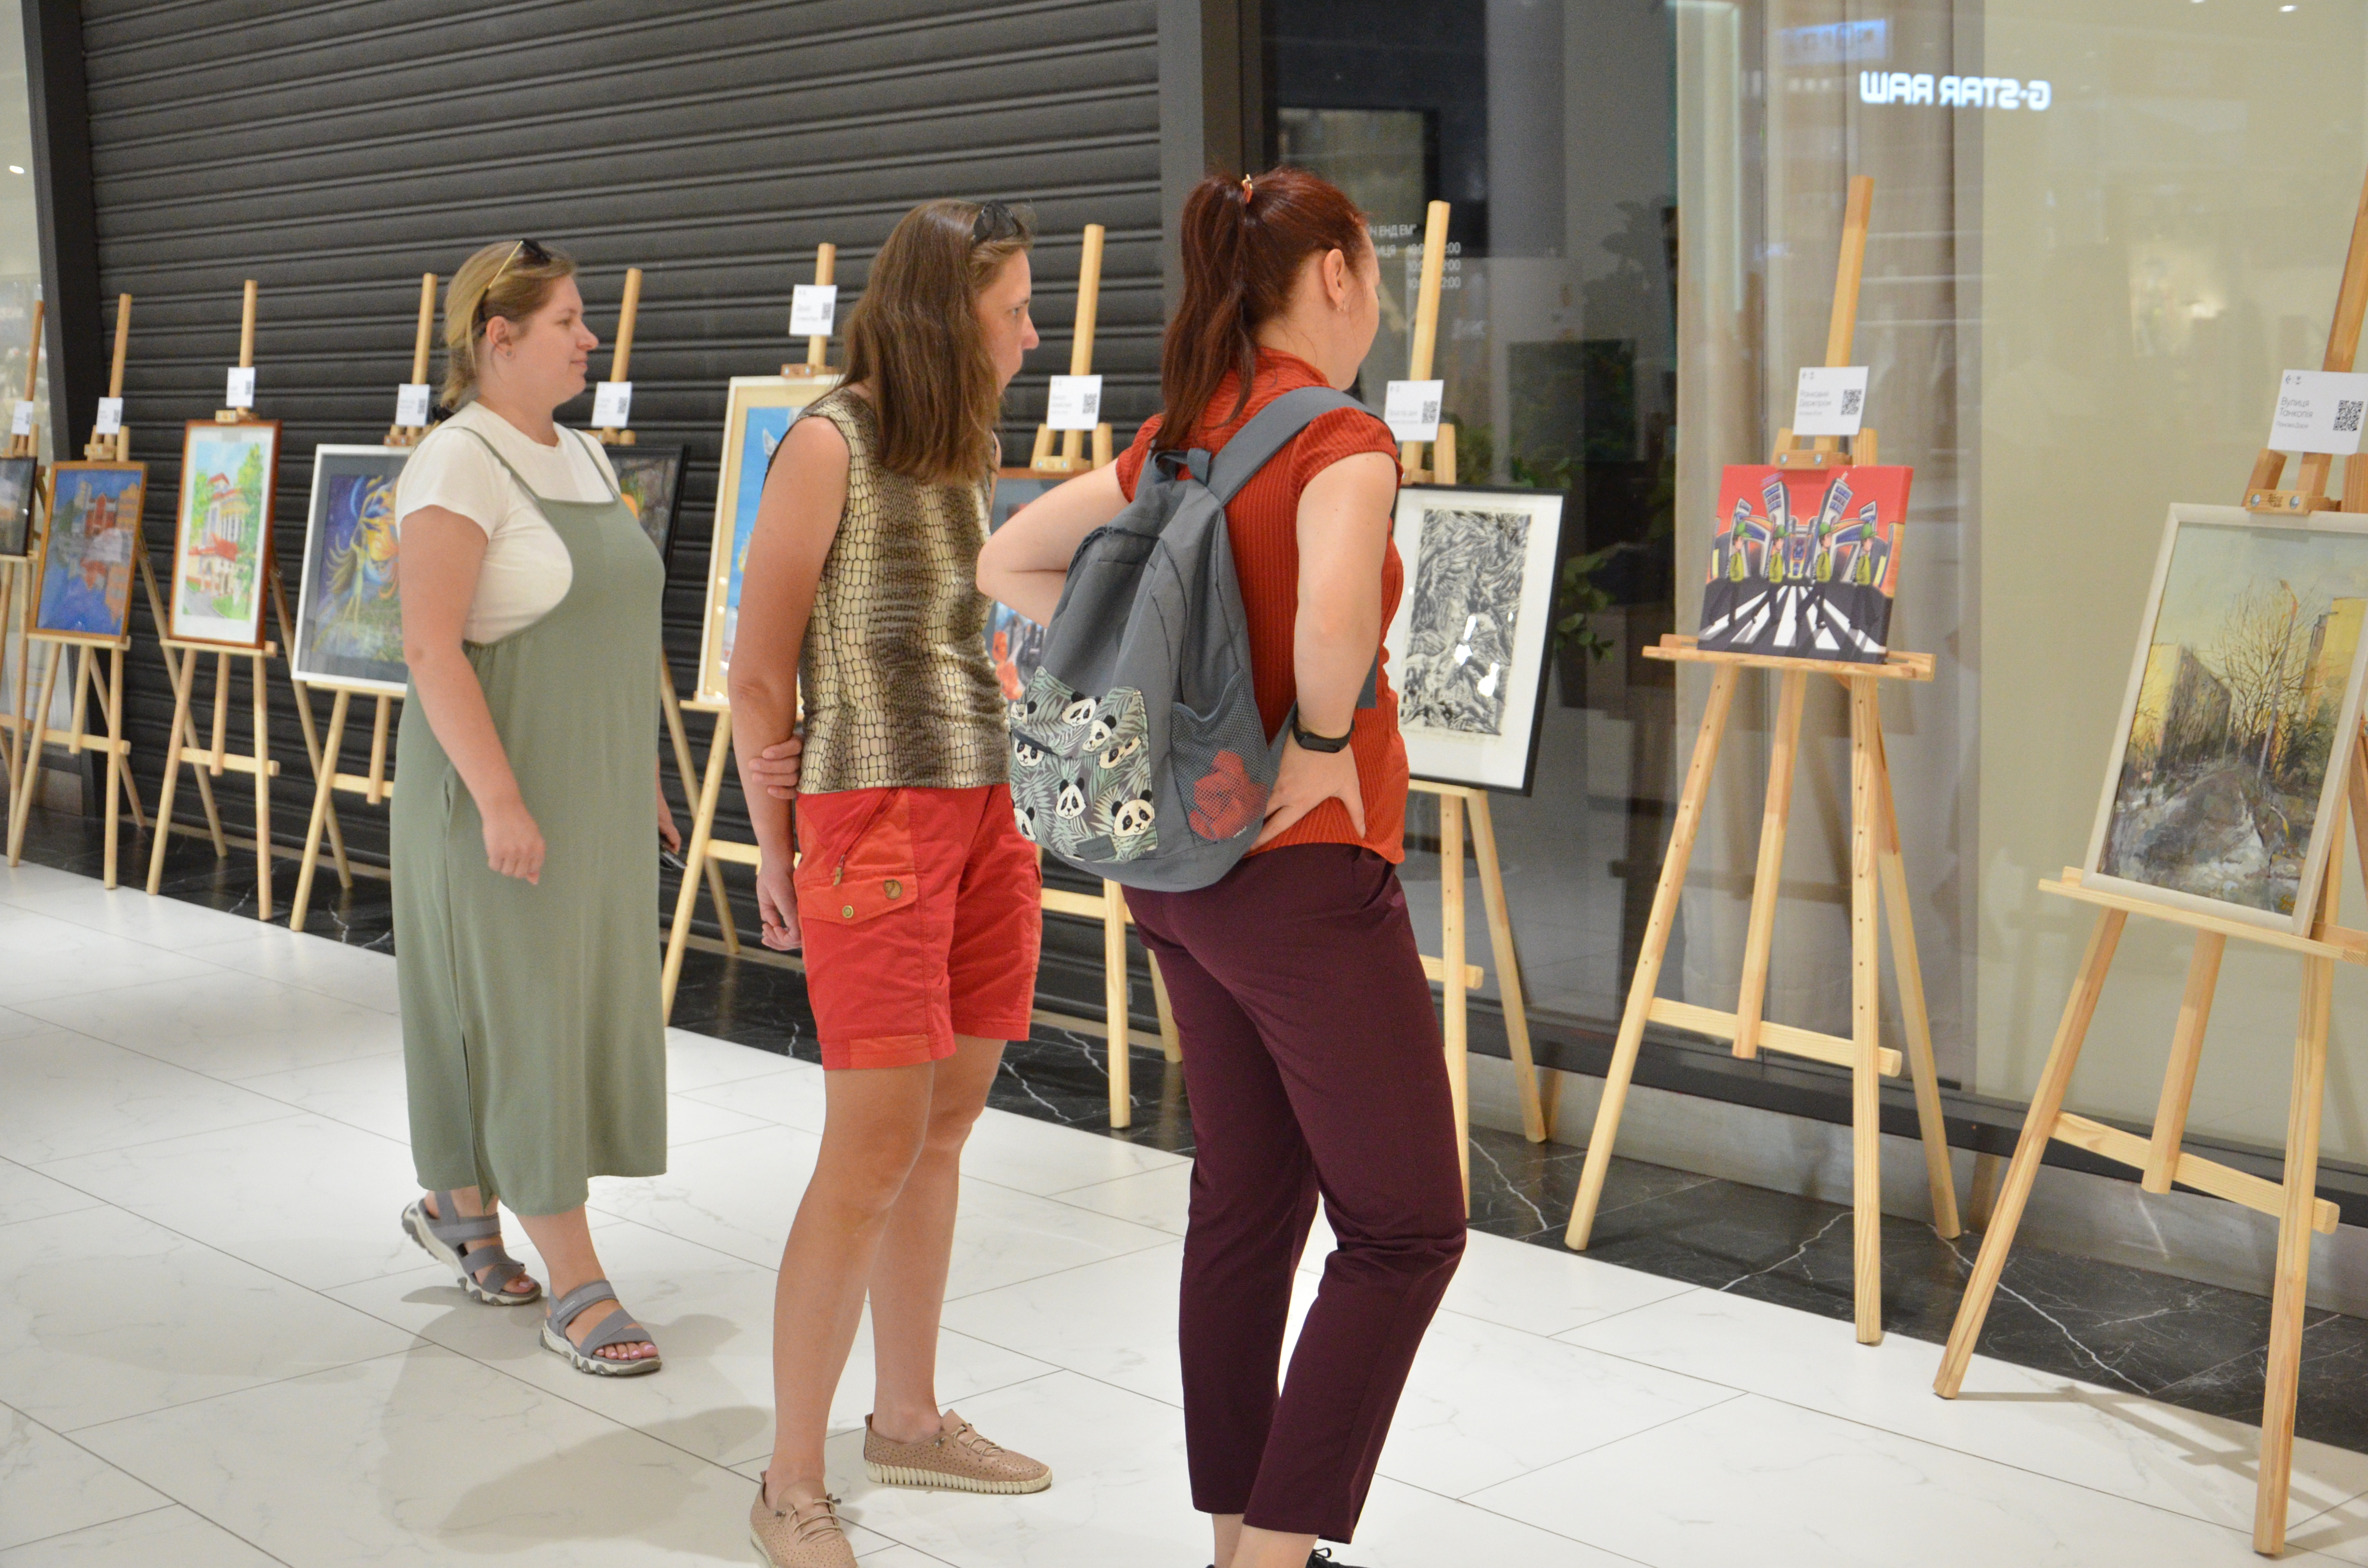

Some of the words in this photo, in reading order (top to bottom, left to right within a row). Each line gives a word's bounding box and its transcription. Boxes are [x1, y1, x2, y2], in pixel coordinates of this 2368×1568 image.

[1375, 245, 1396, 257] ИЦЯ
[1441, 277, 1461, 288] 2:00
[2281, 396, 2309, 407] Вулиця
[2280, 407, 2313, 418] Танкопія
